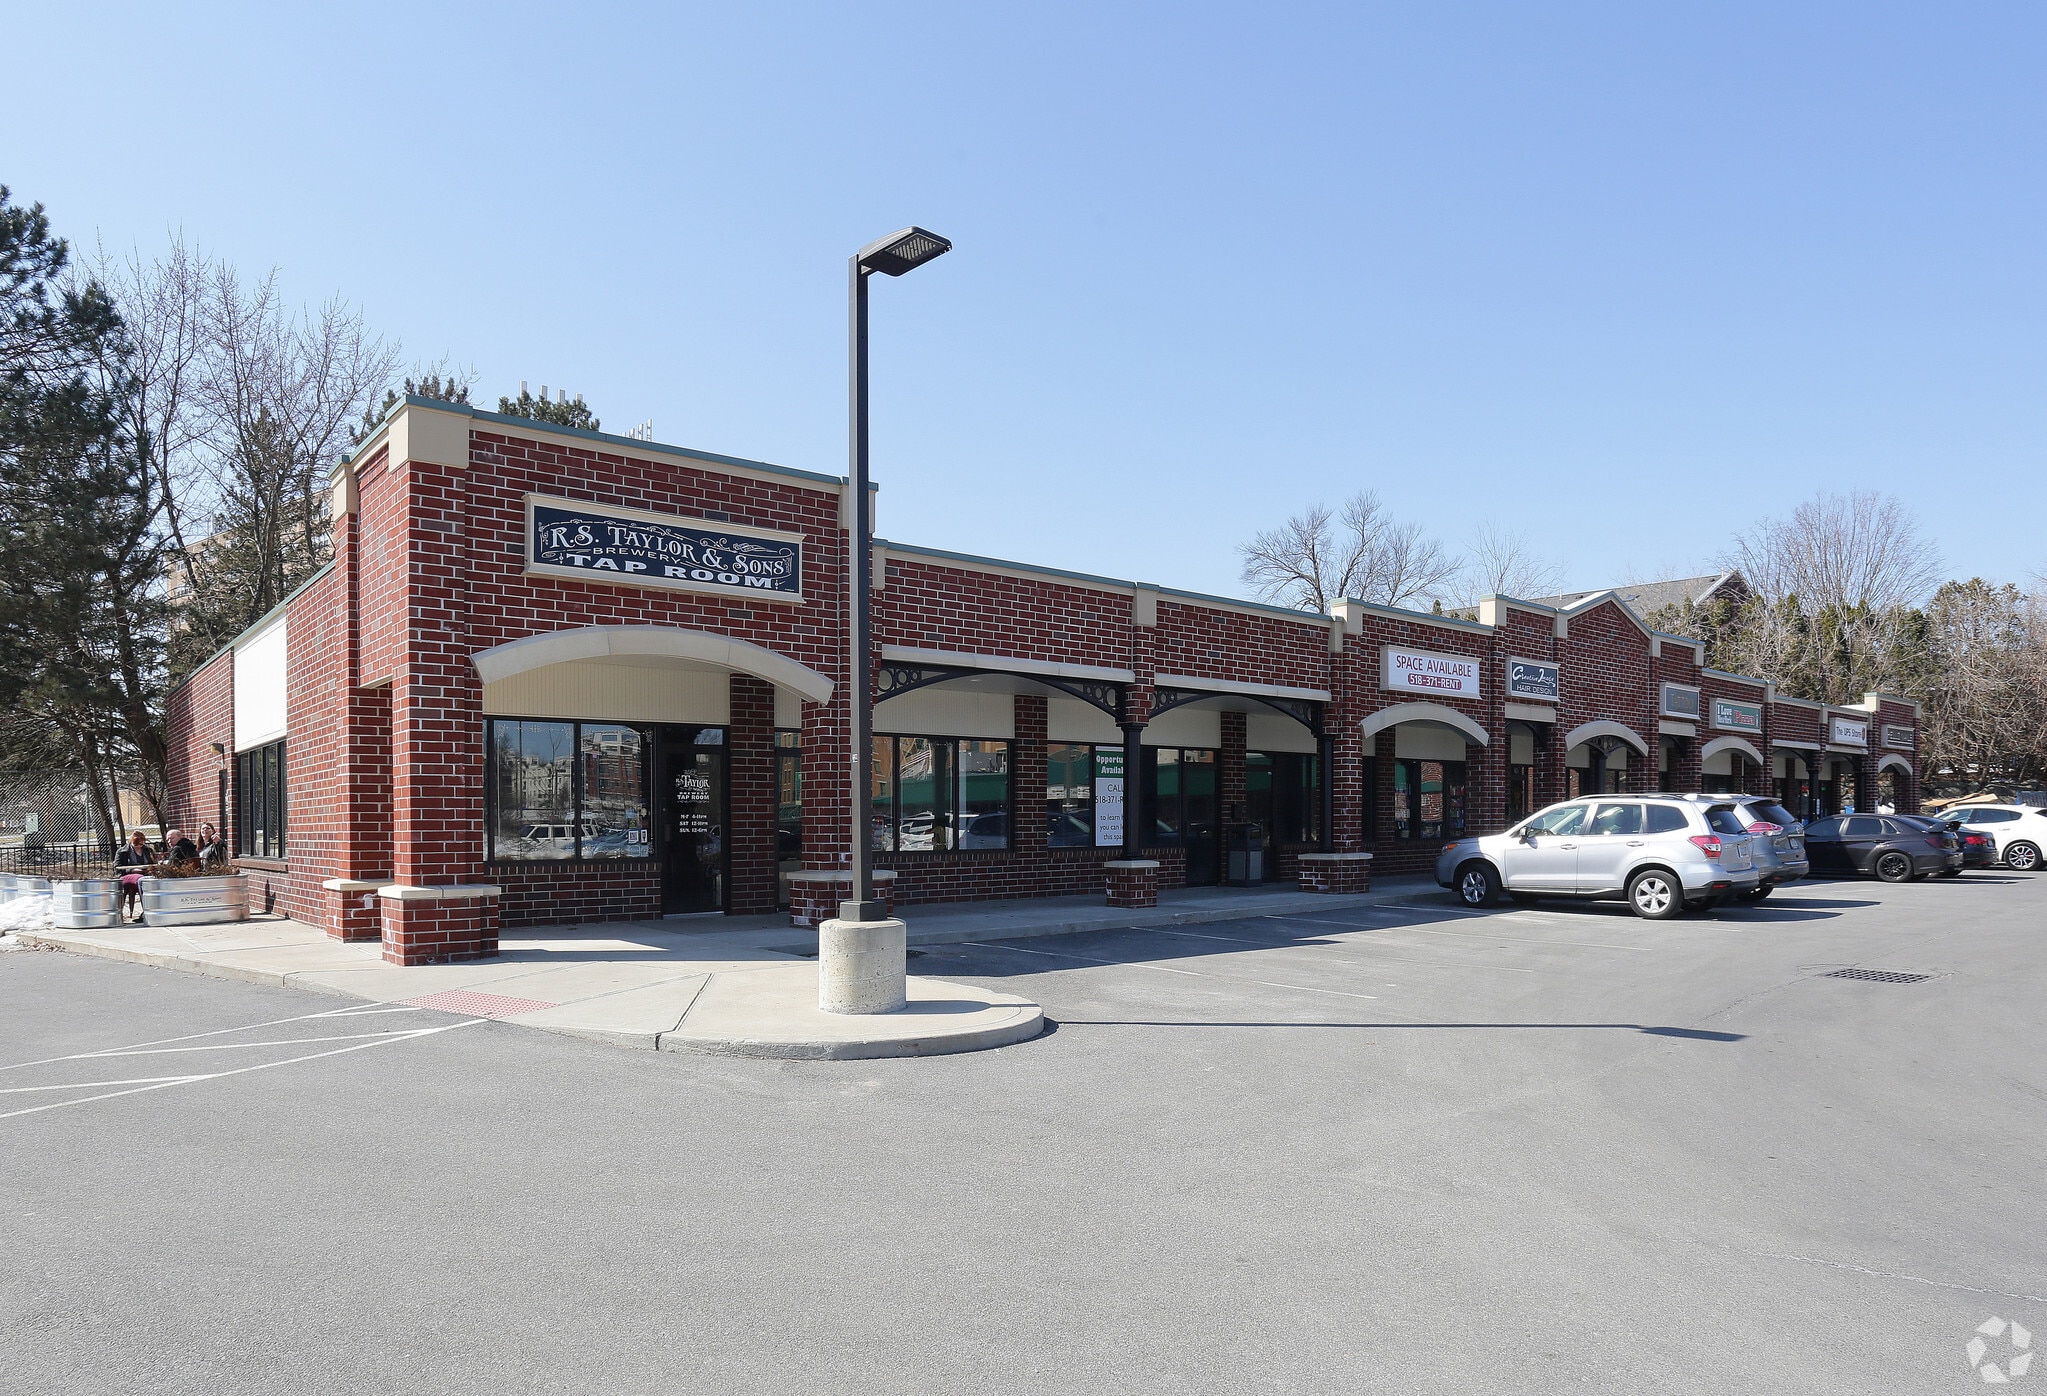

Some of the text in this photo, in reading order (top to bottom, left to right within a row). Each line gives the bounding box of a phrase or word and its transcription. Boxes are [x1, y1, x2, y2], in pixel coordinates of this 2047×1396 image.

[550, 525, 785, 575] R.S. TAYLOR & SONS
[593, 547, 681, 564] BREWERY
[566, 553, 773, 589] TAP ROOM
[1396, 655, 1472, 678] SPACE AVAILABLE
[1410, 674, 1460, 689] 518-371-RENT
[1516, 684, 1553, 695] HAIR DESIGN
[1720, 705, 1733, 716] Love
[1733, 709, 1756, 726] Pizza
[1836, 726, 1862, 738] The UPS Store
[681, 774, 710, 788] TAYLOR
[1107, 813, 1120, 821] learn
[1099, 825, 1109, 833] you
[1103, 833, 1113, 841] this
